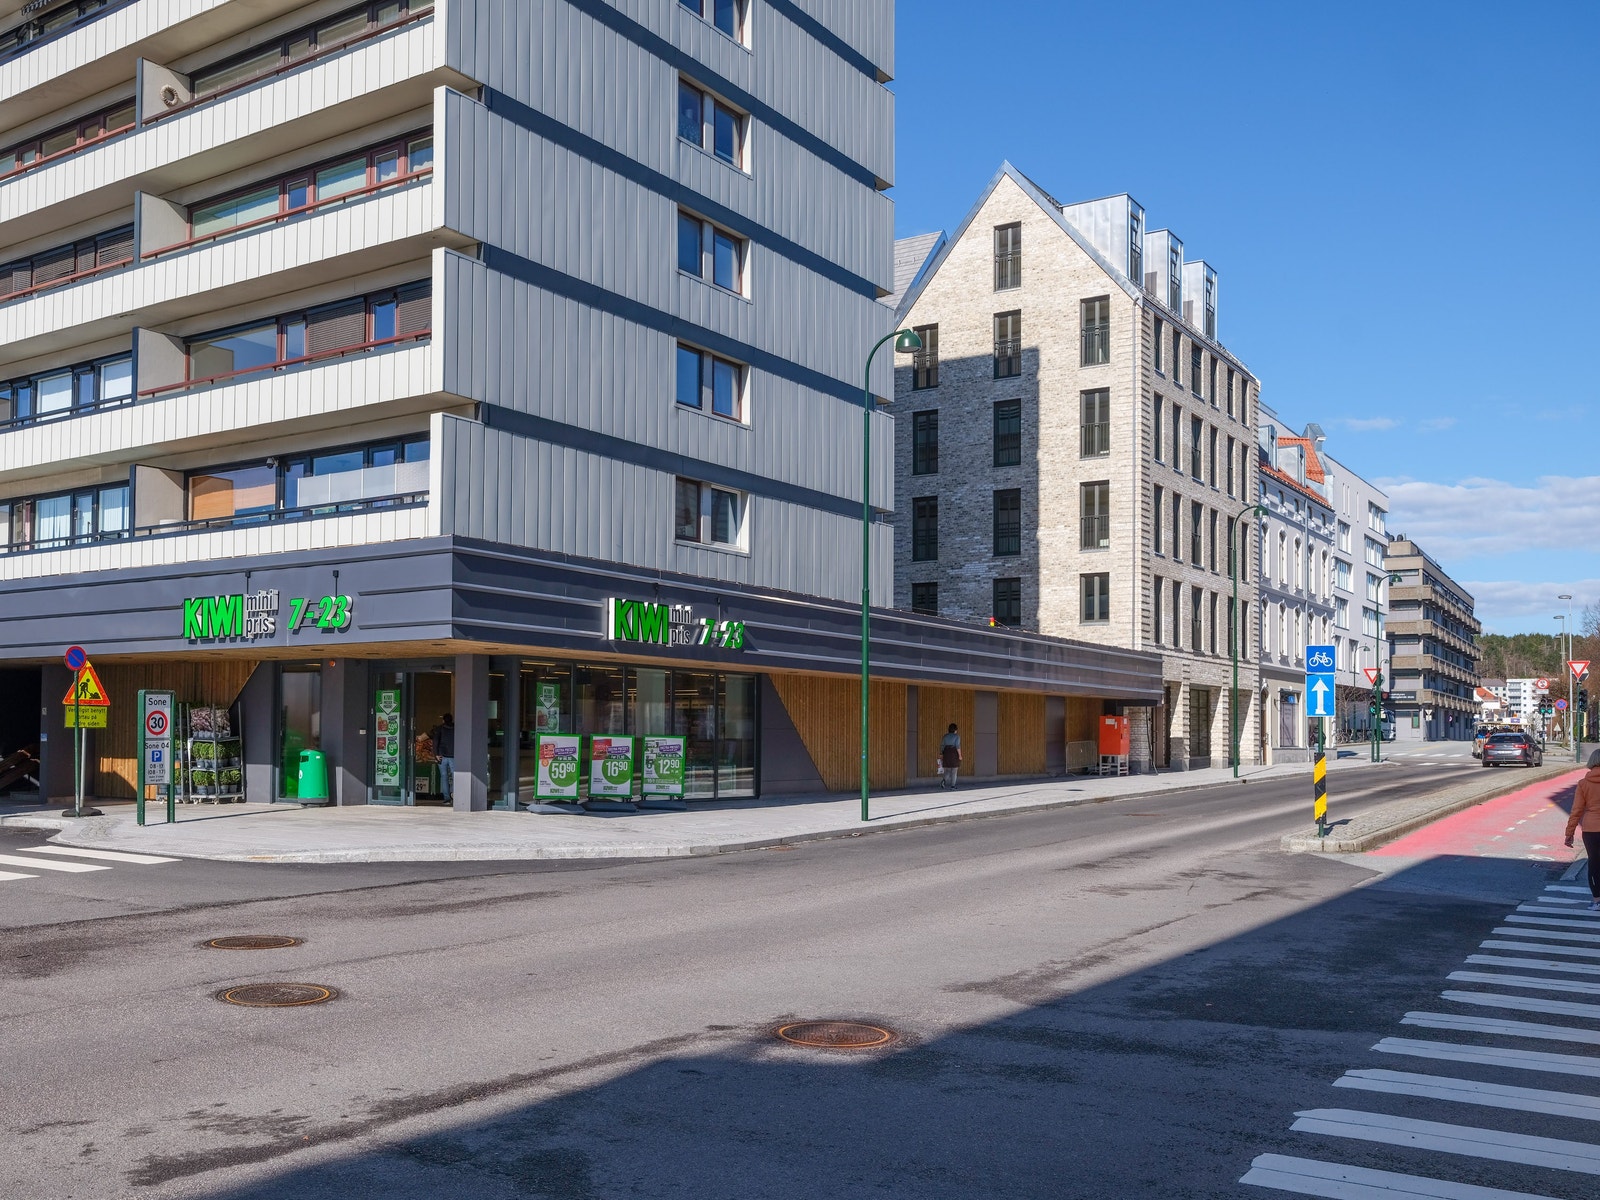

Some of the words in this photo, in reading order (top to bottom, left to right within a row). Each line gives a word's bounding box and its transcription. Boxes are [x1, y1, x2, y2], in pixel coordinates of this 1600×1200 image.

[246, 590, 275, 611] mini
[183, 594, 244, 639] KIWI
[246, 613, 270, 634] pris
[614, 598, 669, 644] KIWI
[671, 605, 693, 624] mini
[671, 625, 690, 645] pris
[148, 697, 167, 706] Sone
[150, 716, 164, 729] 30
